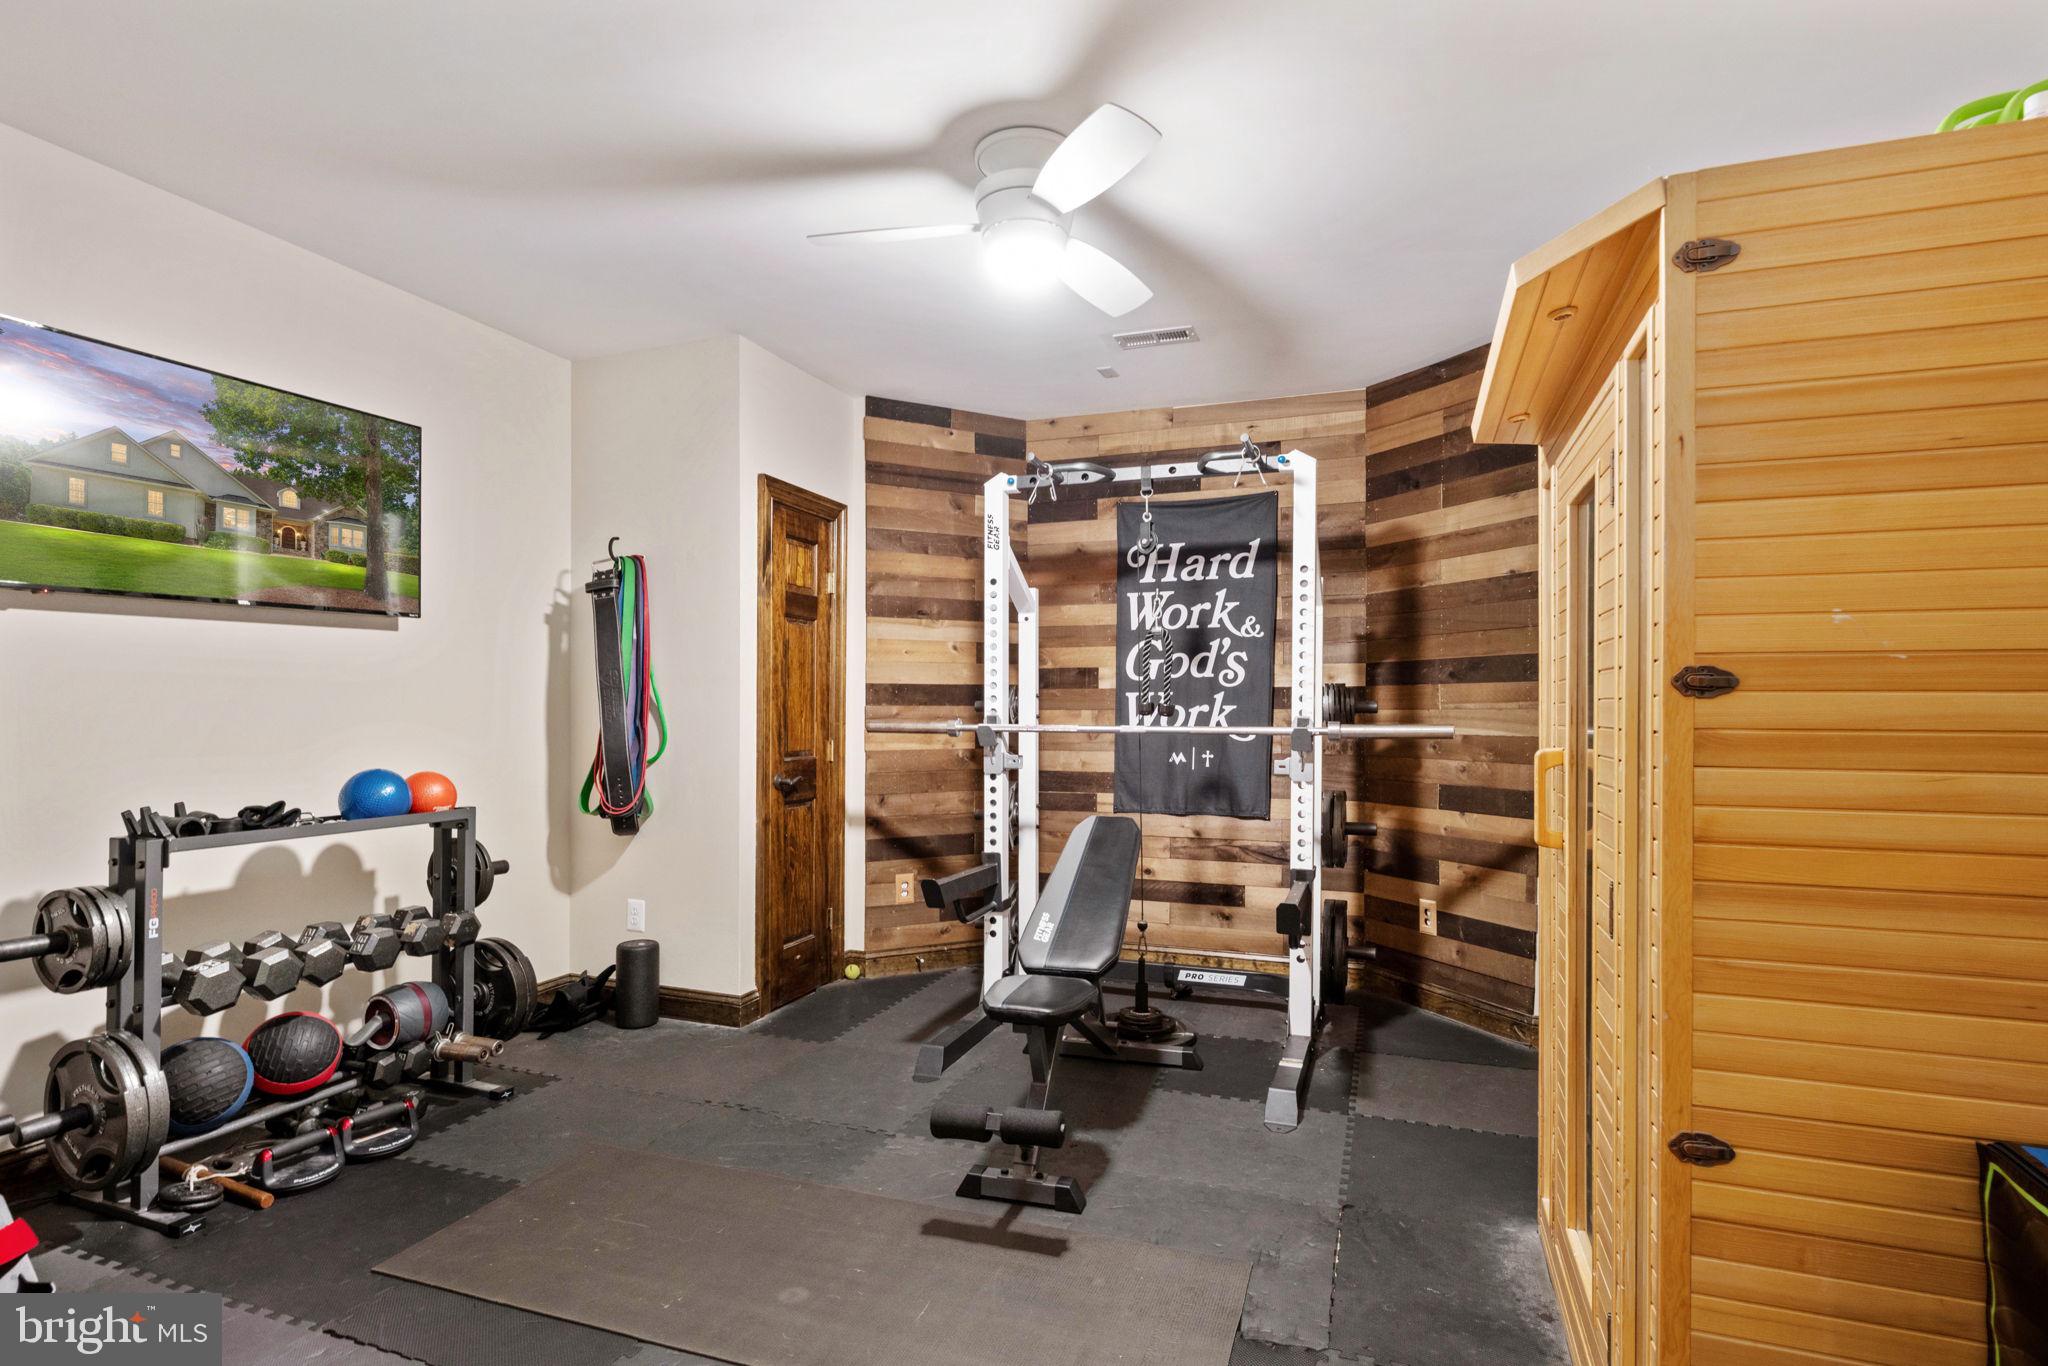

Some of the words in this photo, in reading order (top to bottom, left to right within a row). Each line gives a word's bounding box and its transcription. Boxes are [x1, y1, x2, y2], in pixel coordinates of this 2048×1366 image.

[1126, 537, 1261, 583] Hard
[1126, 588, 1243, 637] Work
[1240, 615, 1265, 638] &
[1125, 637, 1249, 688] God's
[1125, 691, 1257, 742] Work
[1184, 972, 1204, 981] PRO
[1208, 974, 1240, 984] SERIES
